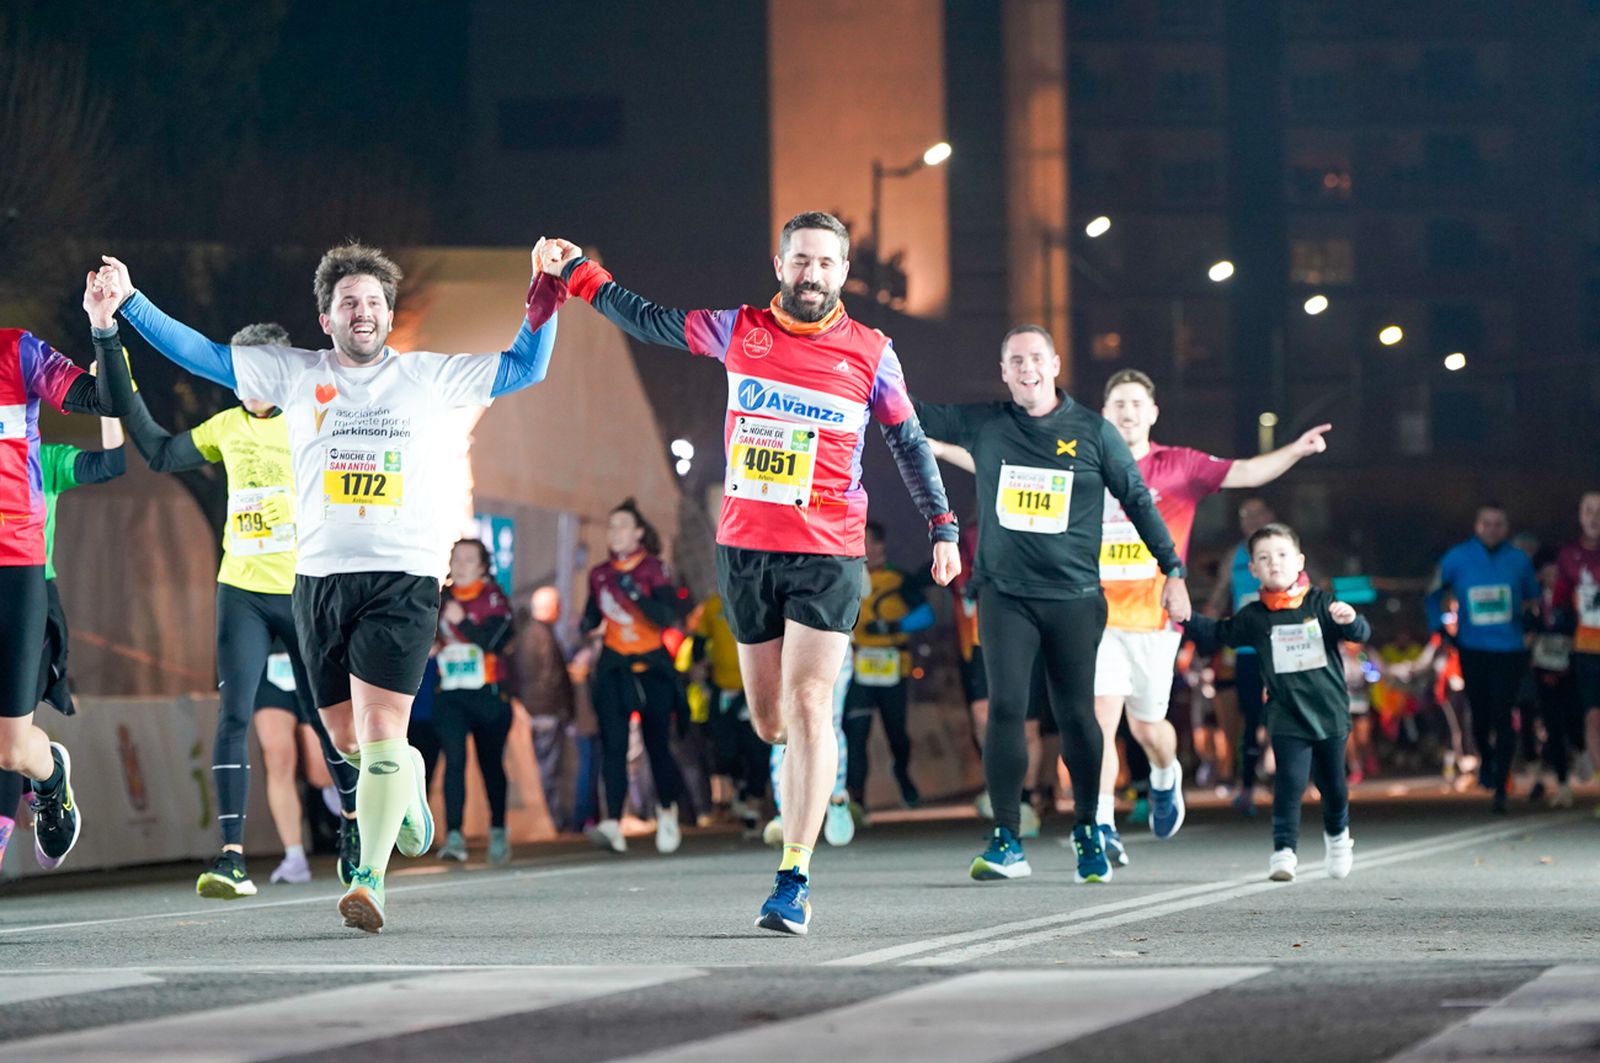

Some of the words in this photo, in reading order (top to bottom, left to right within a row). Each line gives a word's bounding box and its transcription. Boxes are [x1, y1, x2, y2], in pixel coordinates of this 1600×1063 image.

[336, 407, 390, 419] asociación
[766, 392, 845, 423] Avanza
[381, 418, 398, 427] por
[332, 426, 387, 437] parkinson
[389, 427, 411, 438] jaén
[749, 427, 773, 437] NOCHE
[774, 430, 784, 438] DE
[739, 435, 754, 445] SAN
[339, 452, 364, 461] NOCHE
[743, 447, 797, 476] 4051
[329, 461, 346, 471] SAN
[340, 472, 387, 496] 1772
[1017, 490, 1052, 511] 1114
[1108, 543, 1142, 559] 4712
